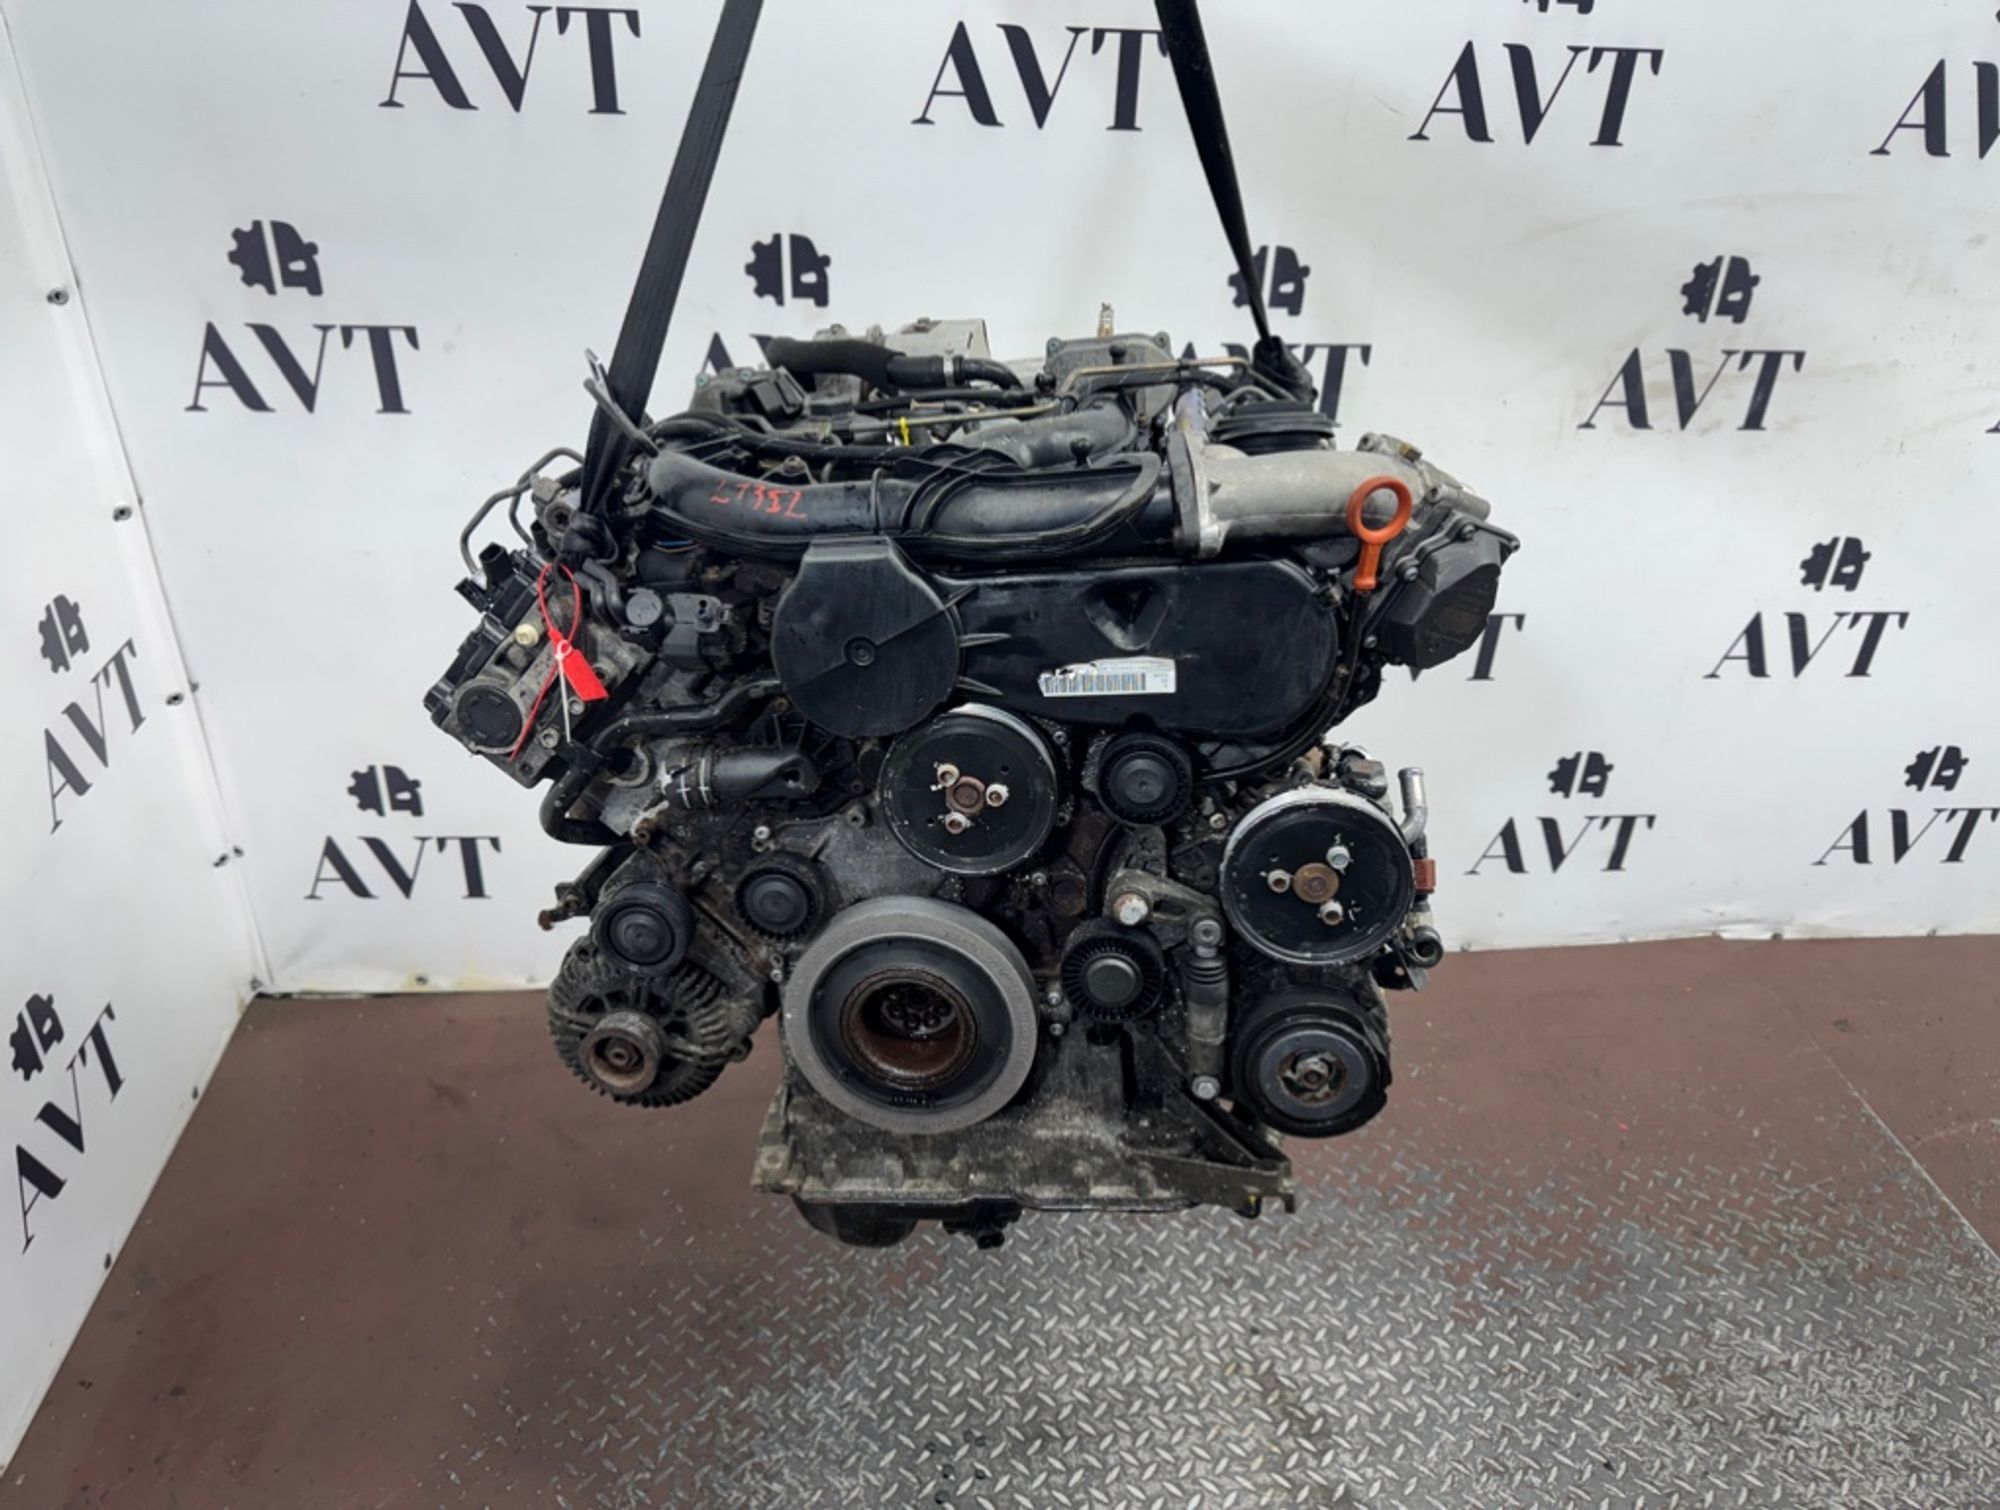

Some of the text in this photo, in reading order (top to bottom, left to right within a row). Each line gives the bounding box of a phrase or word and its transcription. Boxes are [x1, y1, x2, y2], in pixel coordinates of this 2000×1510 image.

[378, 0, 641, 115] AVT
[911, 21, 1168, 132] AVT
[1407, 40, 1664, 147] AVT
[184, 321, 420, 414] AVT
[1577, 347, 1806, 431] AVT
[1702, 611, 1910, 679] AVT
[44, 637, 147, 835] AVT
[303, 835, 502, 900] AVT
[1463, 813, 1657, 876] AVT
[1811, 807, 2000, 866] AVT
[15, 1002, 125, 1255] AVT
